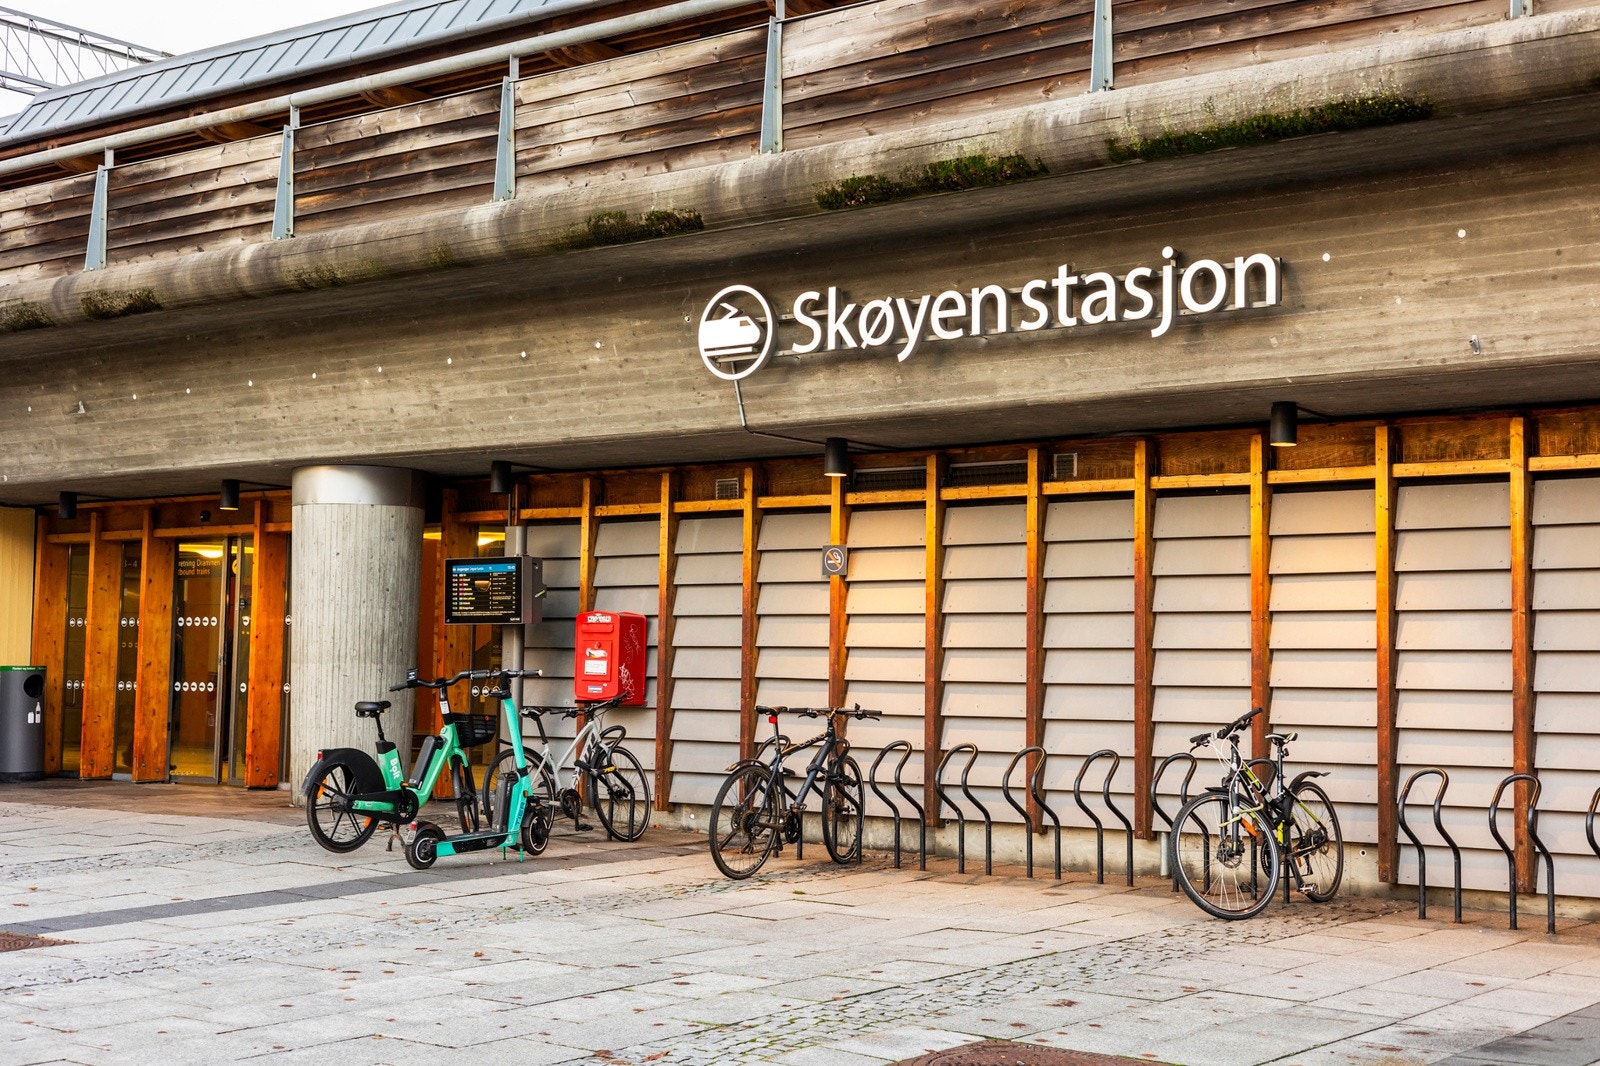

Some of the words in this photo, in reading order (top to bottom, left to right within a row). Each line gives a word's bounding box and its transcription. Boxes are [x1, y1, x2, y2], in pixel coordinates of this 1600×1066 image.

[791, 286, 1007, 362] Skøyen
[1020, 246, 1280, 338] stasjon
[196, 559, 221, 567] Drammen
[196, 567, 210, 576] trains
[390, 757, 400, 780] Bolt
